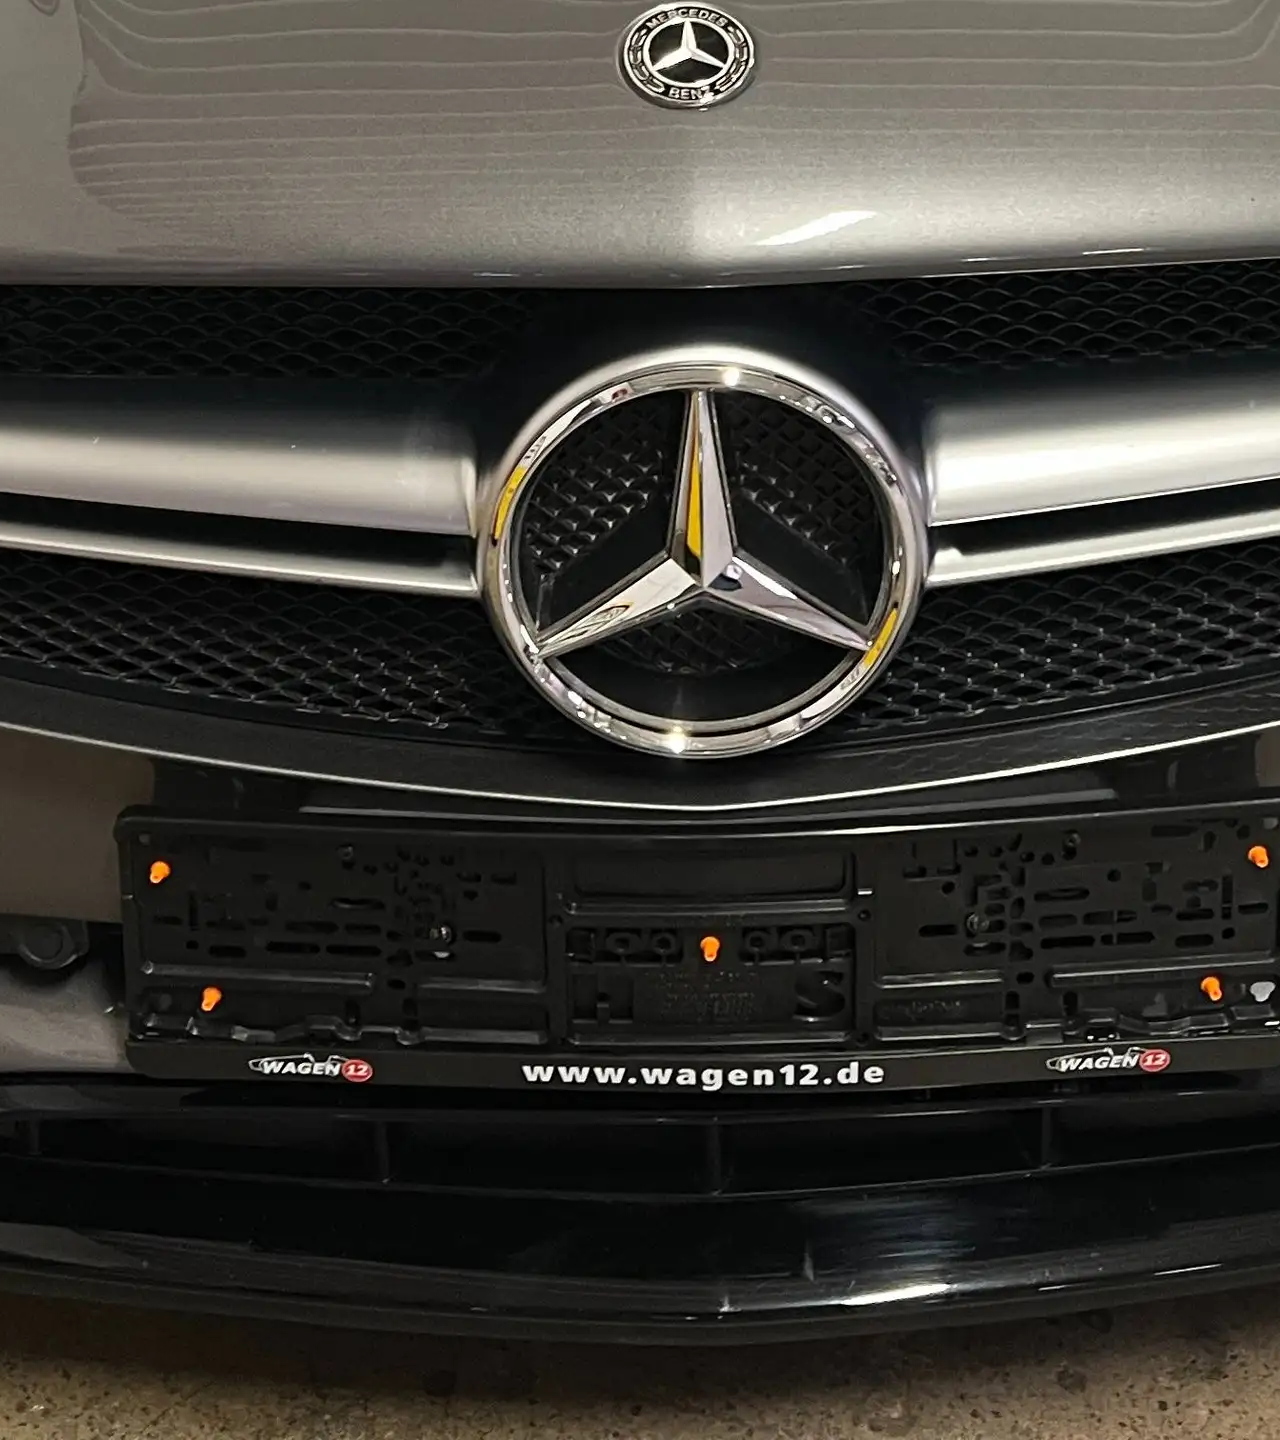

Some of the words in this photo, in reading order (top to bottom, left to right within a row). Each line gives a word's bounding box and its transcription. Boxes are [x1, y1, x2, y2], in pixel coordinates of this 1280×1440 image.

[646, 8, 729, 30] MERCEDES
[667, 85, 715, 101] BENZ
[262, 1061, 341, 1076] WAGEN
[1060, 1054, 1140, 1072] WAGEN
[522, 1061, 885, 1091] www.wagen12.de
